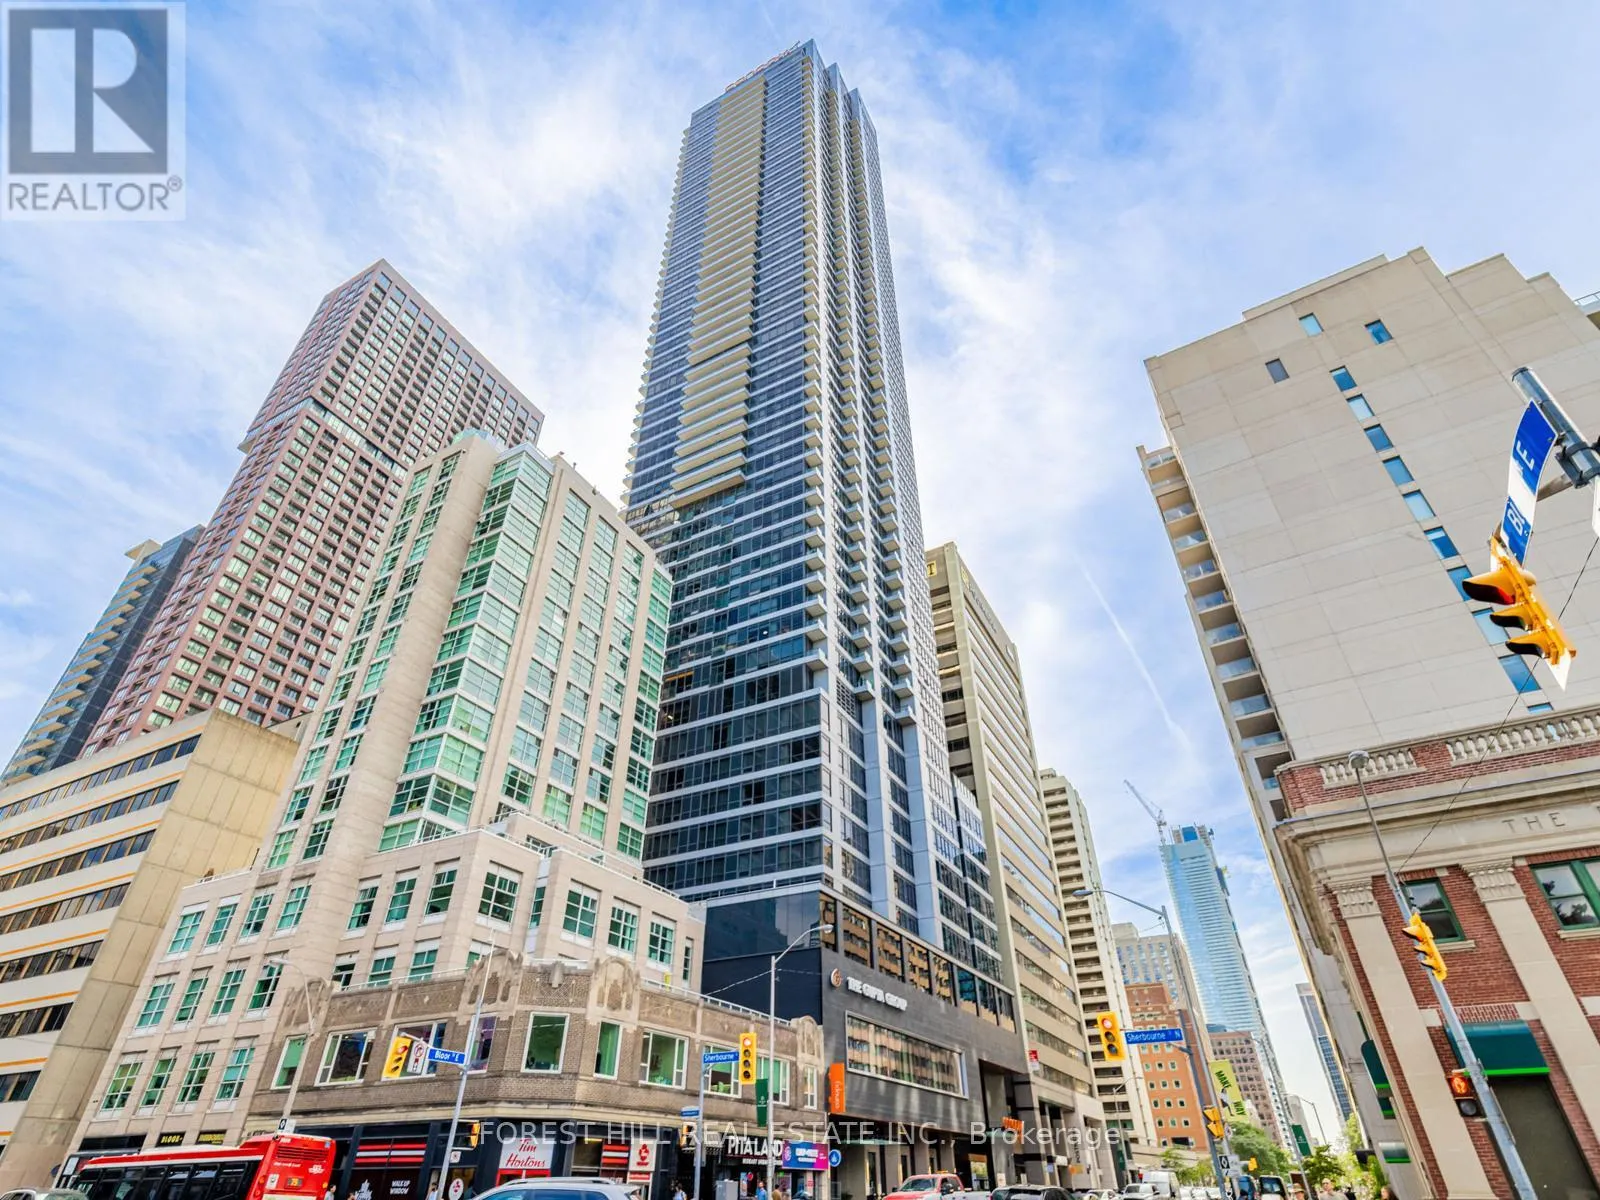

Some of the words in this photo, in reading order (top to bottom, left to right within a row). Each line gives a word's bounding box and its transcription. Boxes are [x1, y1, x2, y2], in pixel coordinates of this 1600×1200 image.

[1516, 440, 1535, 471] E
[1501, 811, 1566, 834] THE
[1126, 1032, 1167, 1042] Sherbourne
[1174, 1030, 1181, 1039] N
[434, 1050, 450, 1060] Bloor
[704, 1053, 734, 1062] Sherbourne
[1215, 1070, 1232, 1088] MAKE
[1233, 1100, 1247, 1116] WAY
[519, 1138, 537, 1152] Tim
[505, 1153, 546, 1167] Hortons
